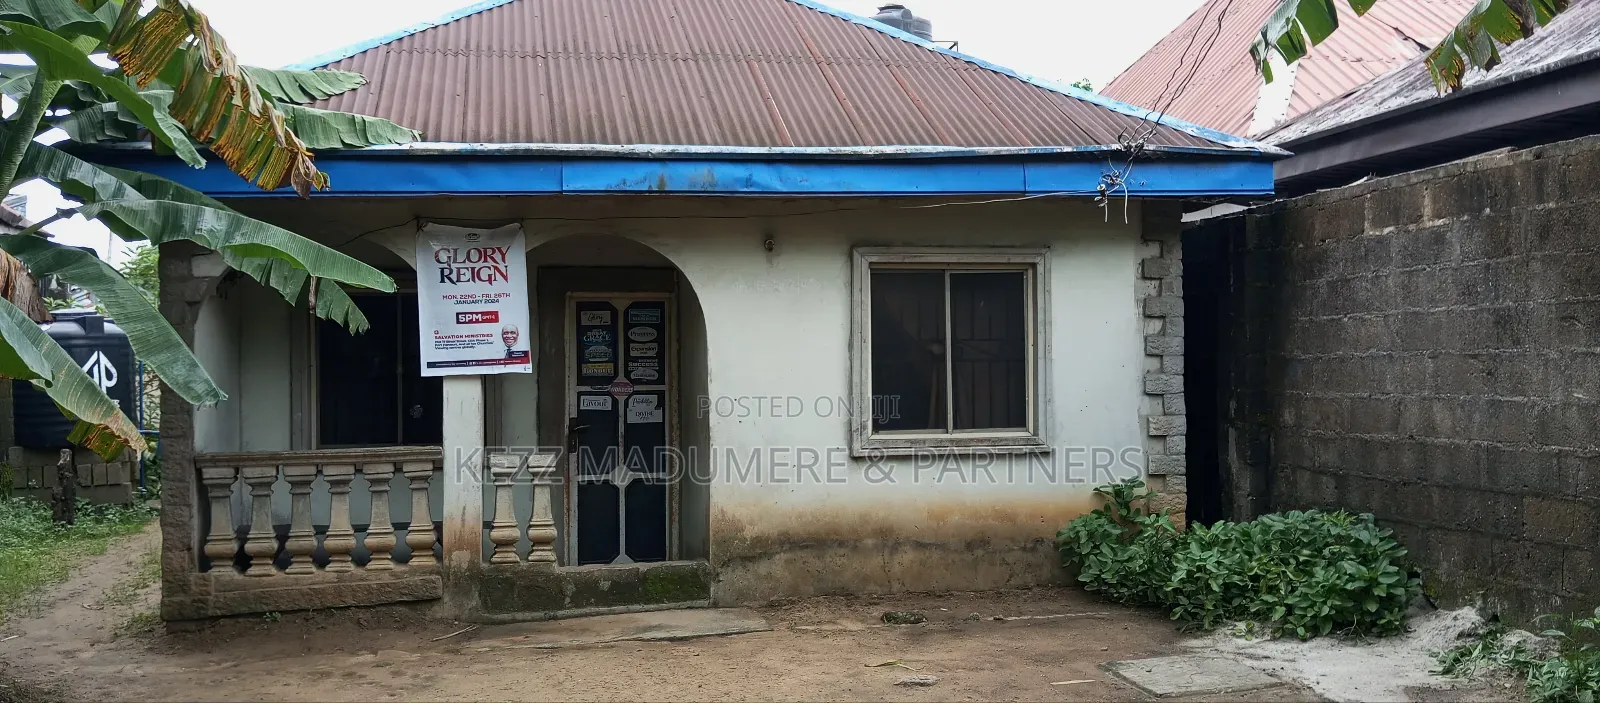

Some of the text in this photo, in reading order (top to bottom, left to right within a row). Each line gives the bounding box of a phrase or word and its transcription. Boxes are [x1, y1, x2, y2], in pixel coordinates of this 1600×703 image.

[434, 245, 511, 268] GLORY
[439, 265, 509, 286] REIGN
[458, 314, 482, 323] 5PM
